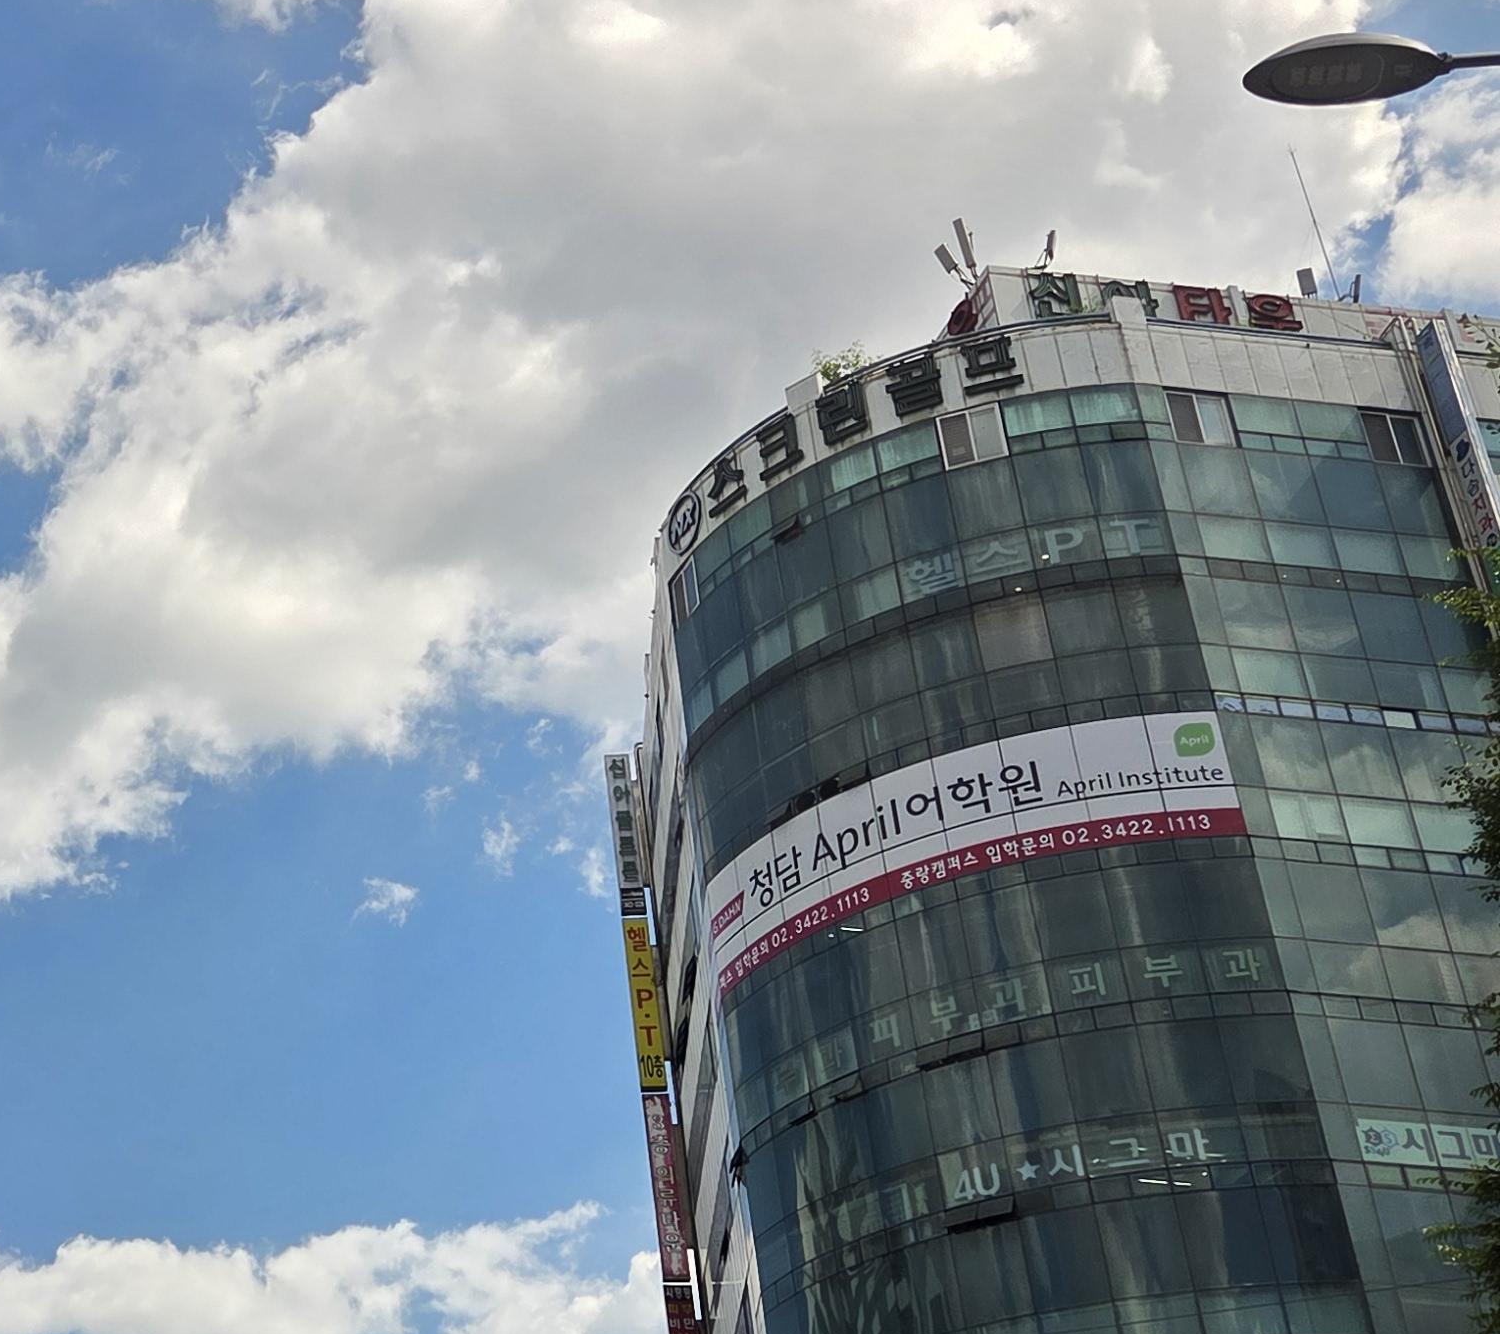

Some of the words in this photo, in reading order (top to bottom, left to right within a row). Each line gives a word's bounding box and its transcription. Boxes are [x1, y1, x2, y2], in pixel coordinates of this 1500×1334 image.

[1179, 733, 1210, 748] April
[749, 844, 802, 908] 청담
[1056, 772, 1113, 800] April
[1118, 764, 1225, 789] Institute
[900, 849, 980, 891] 중랑캠퍼스
[985, 832, 1056, 864] 입학문의
[1068, 948, 1263, 996] 피부과
[639, 1052, 665, 1080] 10층
